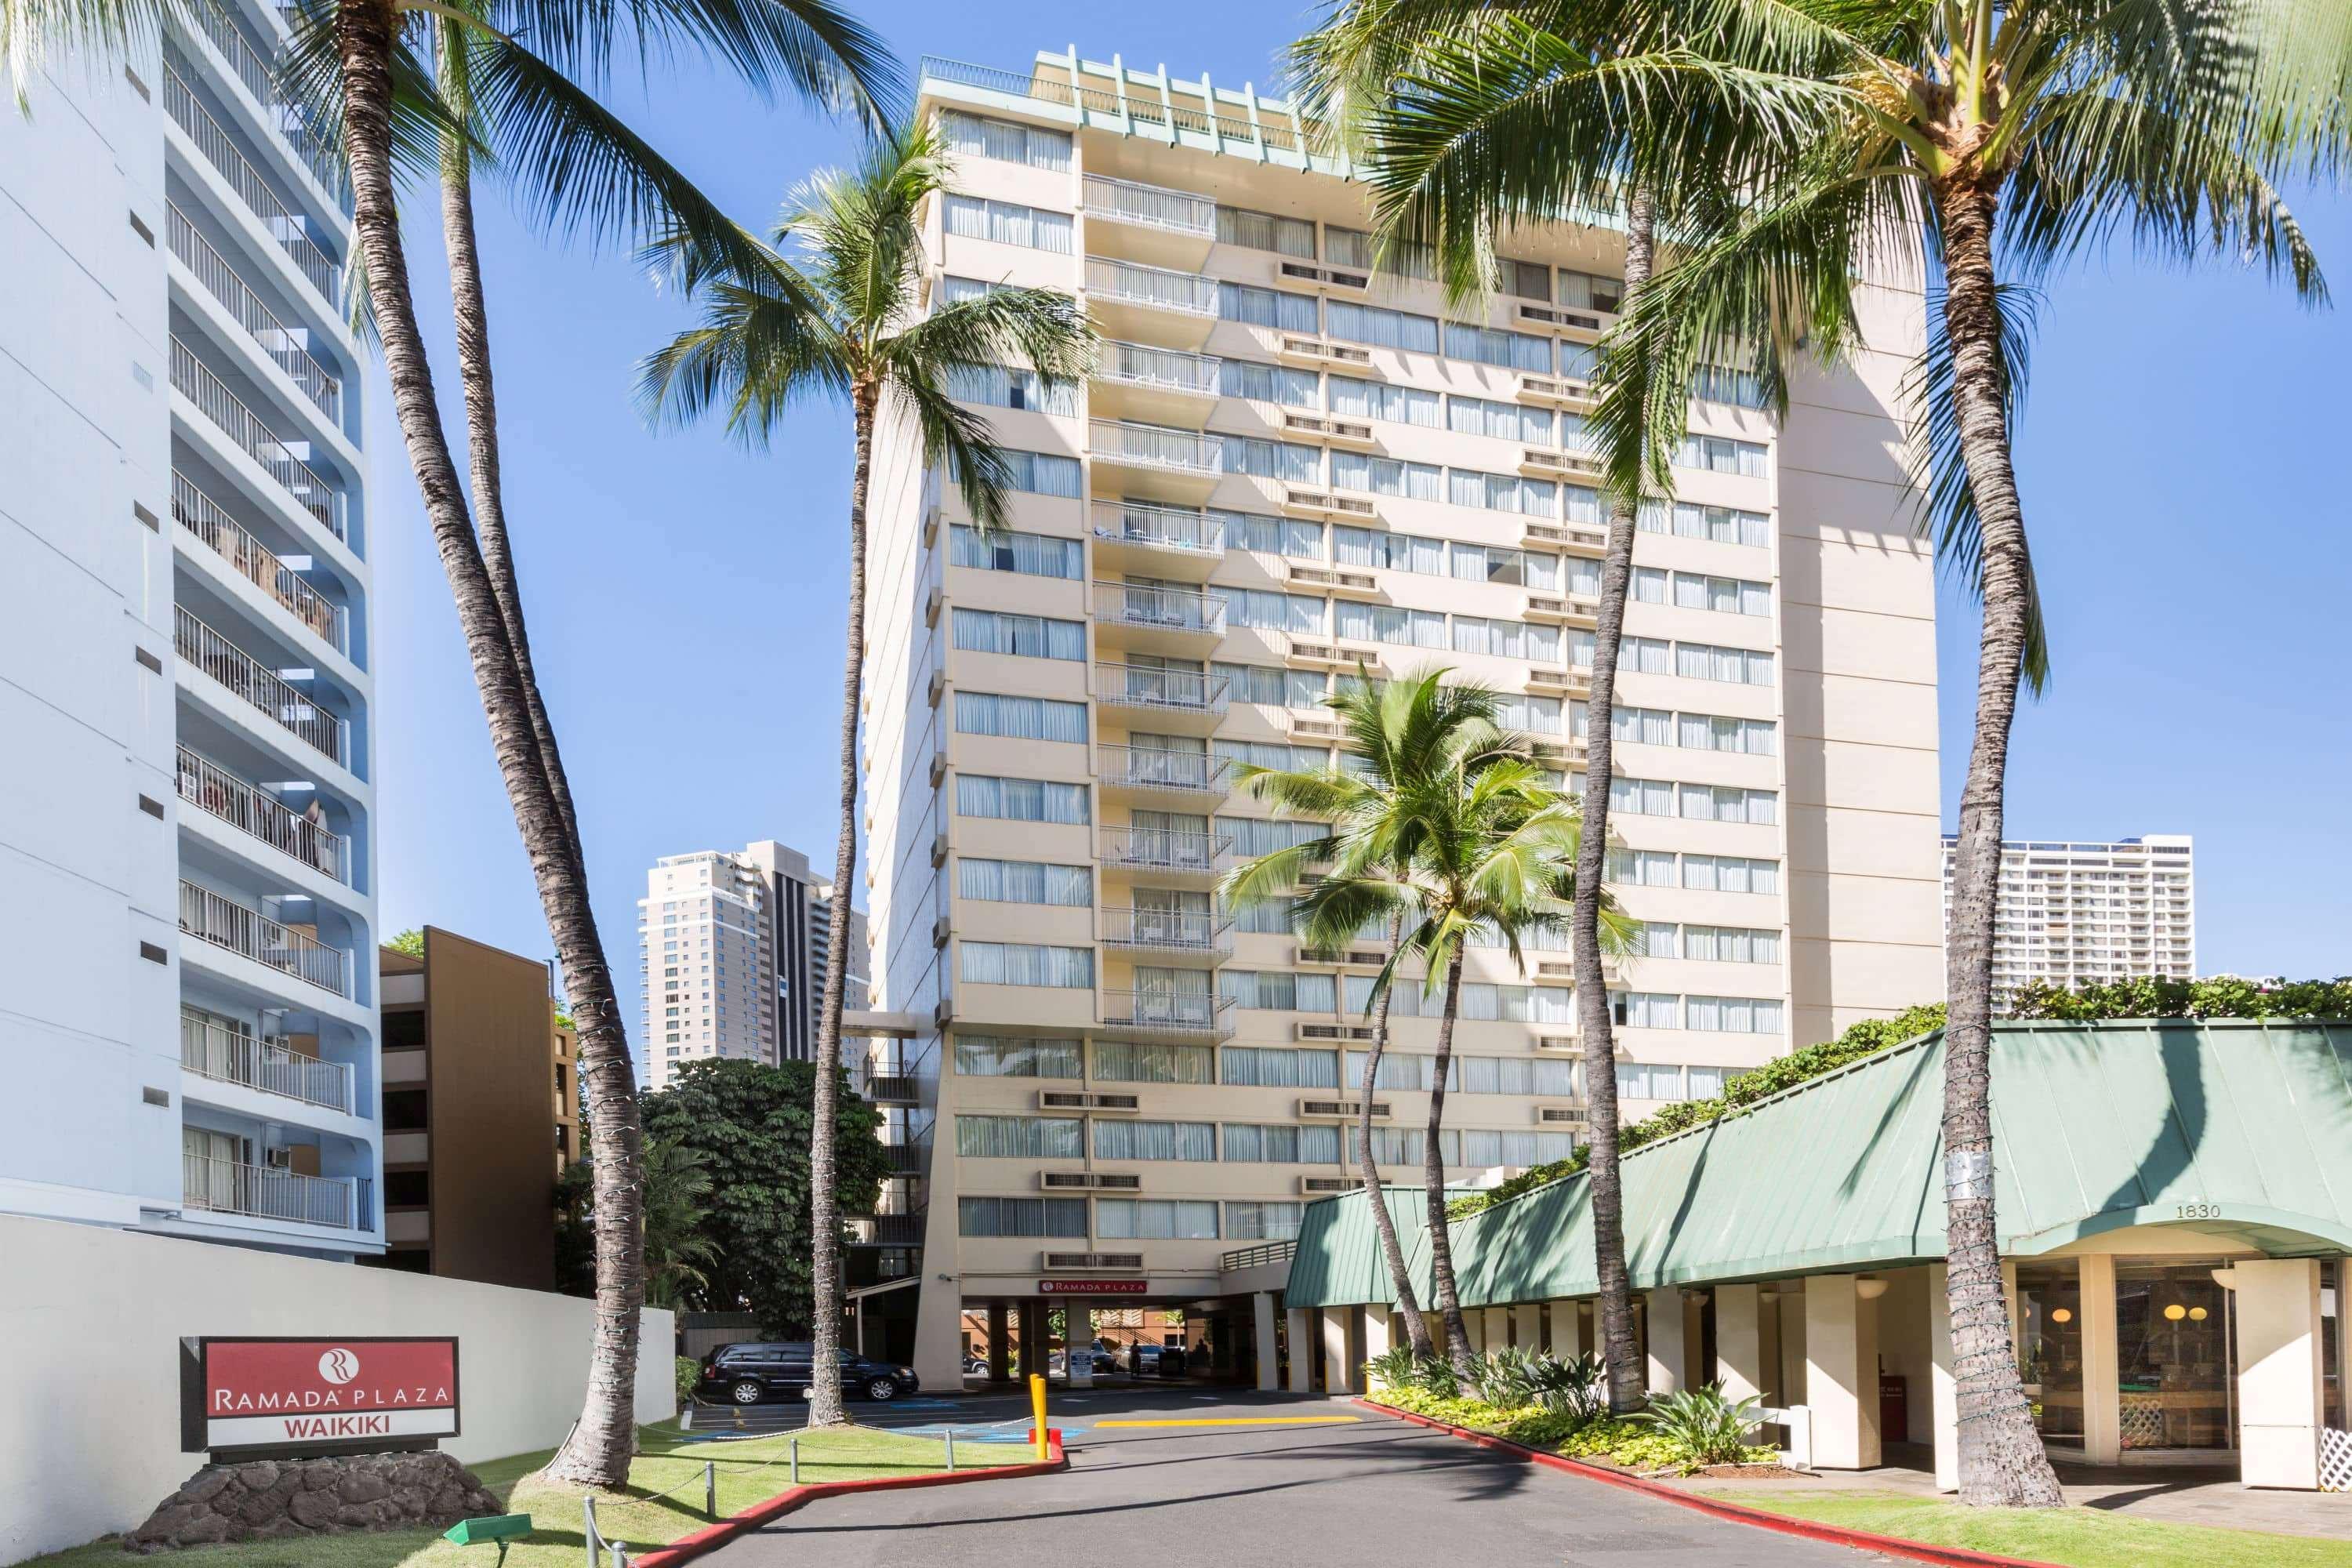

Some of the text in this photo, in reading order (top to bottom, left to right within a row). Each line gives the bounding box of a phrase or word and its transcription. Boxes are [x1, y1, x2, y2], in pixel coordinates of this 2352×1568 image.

[2177, 1204, 2220, 1218] 1830
[1056, 1283, 1100, 1291] RAMADA
[215, 1387, 448, 1410] RAMADA PLAZA
[285, 1415, 390, 1439] WAIKIKI
